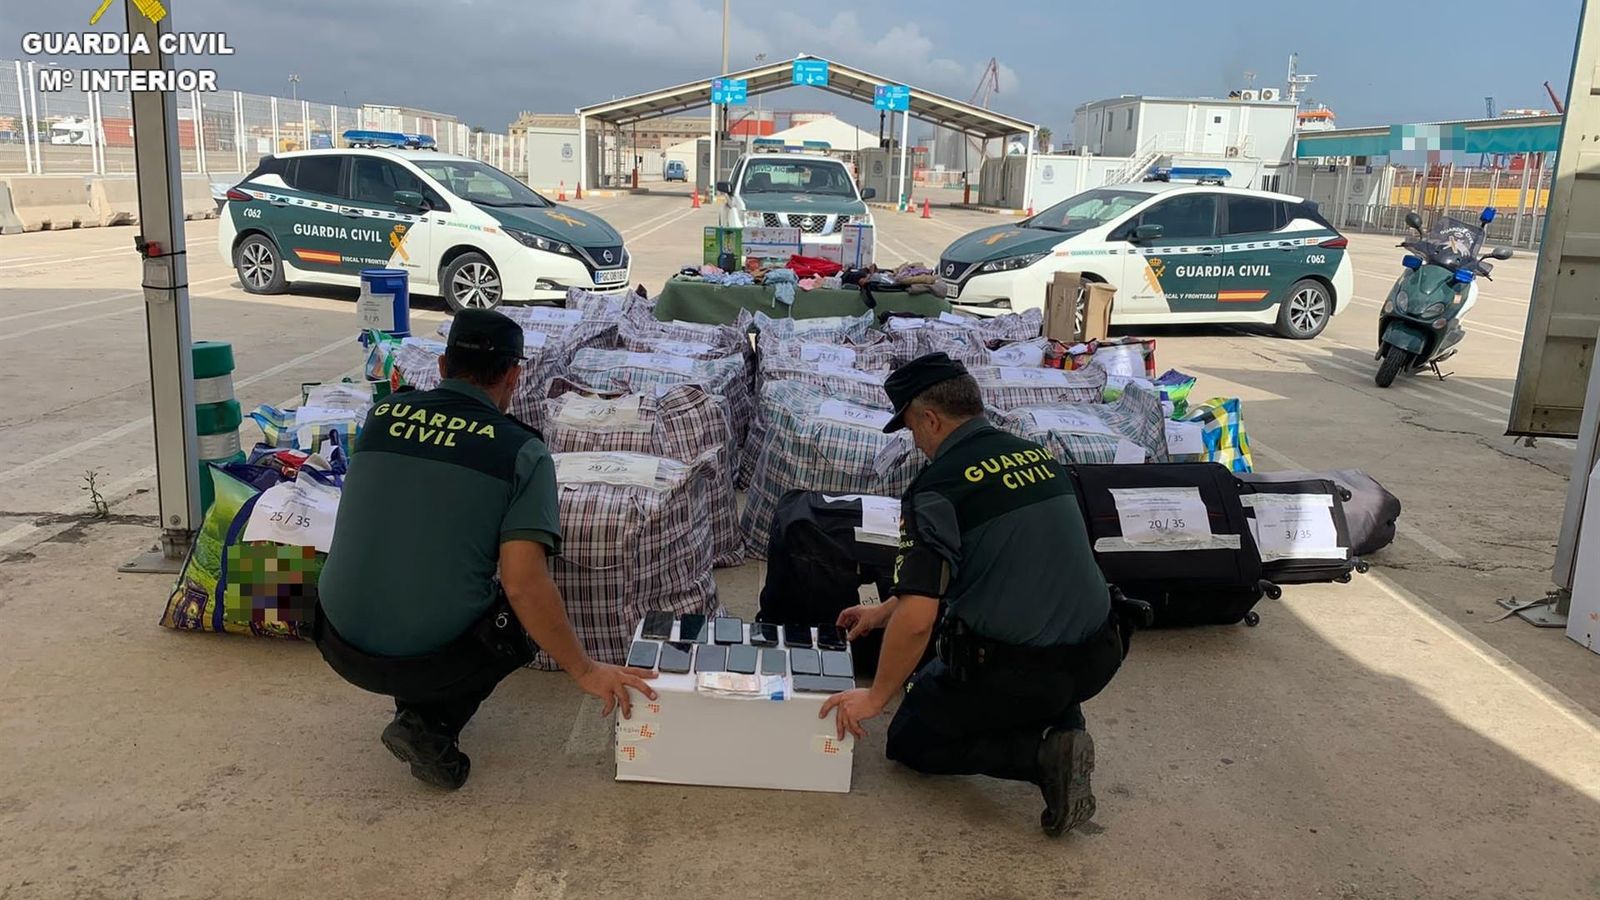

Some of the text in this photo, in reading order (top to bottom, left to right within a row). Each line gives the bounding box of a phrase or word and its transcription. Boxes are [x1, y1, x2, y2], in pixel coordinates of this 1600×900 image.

[293, 223, 383, 243] GUARDIA CIVIL
[1311, 254, 1326, 264] 062
[1175, 265, 1271, 277] GUARDIA CIVIL
[605, 406, 617, 415] 35
[374, 403, 495, 438] GUARDIA
[389, 421, 456, 447] CIVIL
[1174, 434, 1184, 442] 35
[964, 447, 1056, 482] GUARDIA
[1002, 464, 1056, 490] CIVIL
[269, 511, 311, 528] 25 / 35
[1148, 518, 1186, 530] 20 / 35
[1285, 529, 1312, 540] 3 / 35
